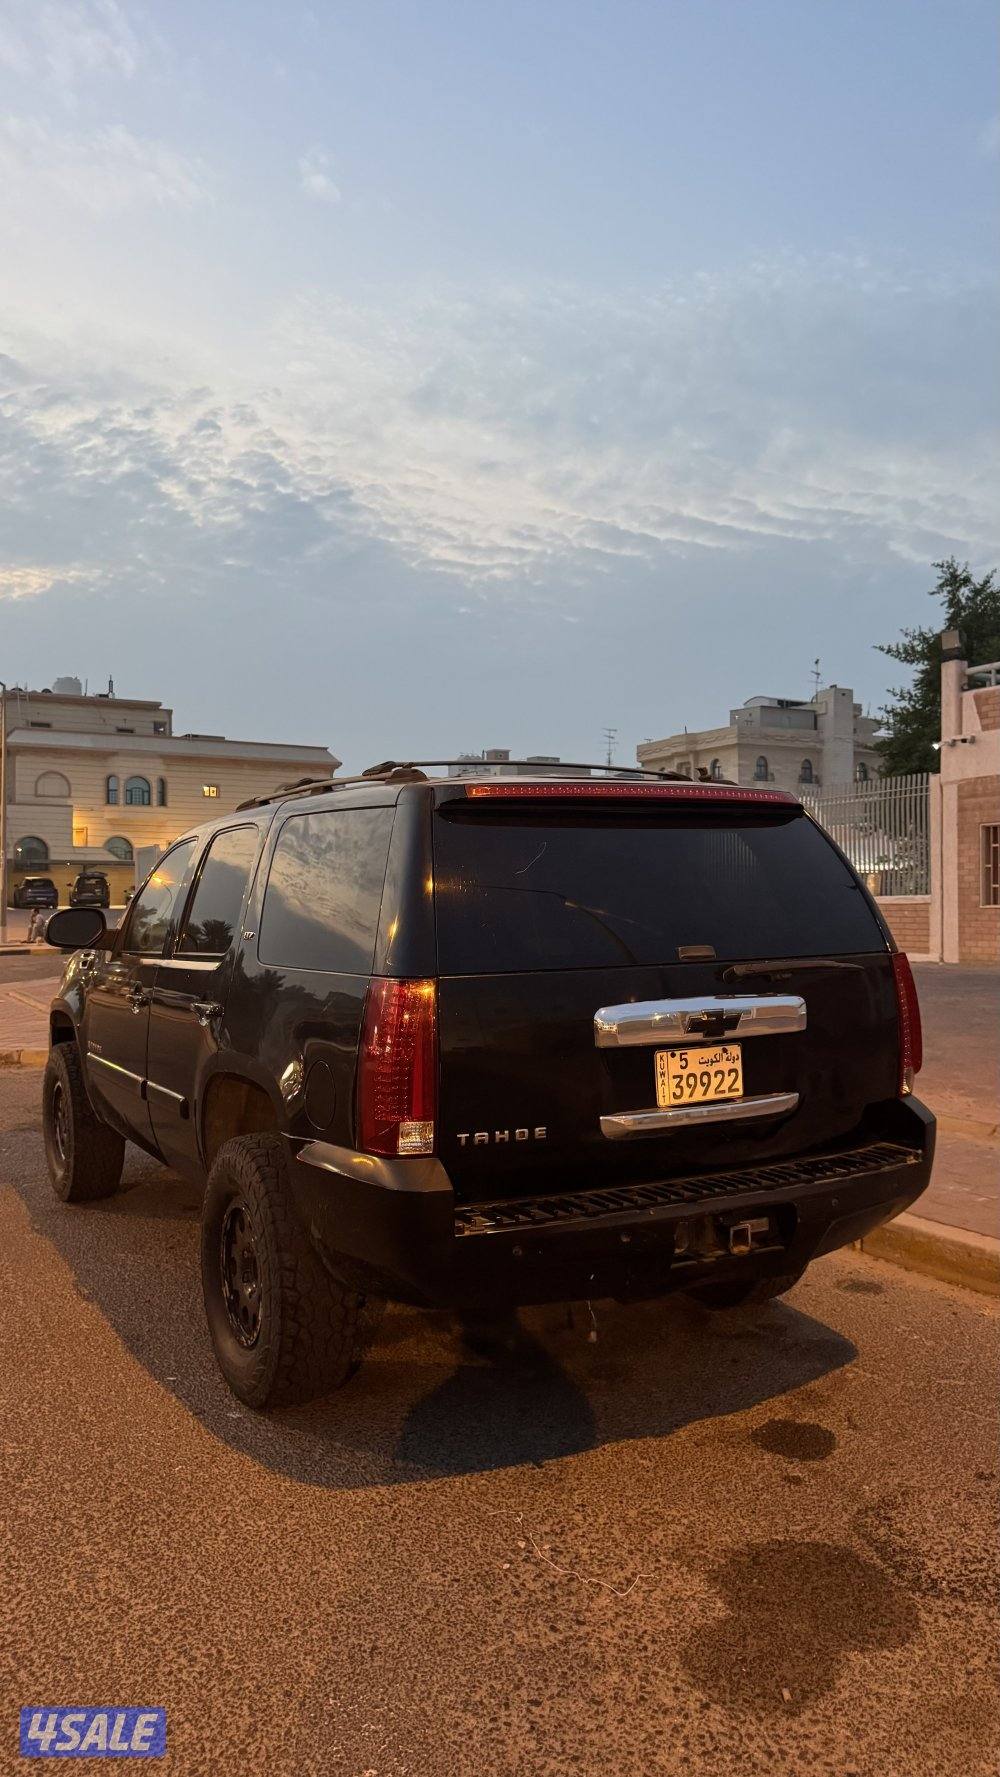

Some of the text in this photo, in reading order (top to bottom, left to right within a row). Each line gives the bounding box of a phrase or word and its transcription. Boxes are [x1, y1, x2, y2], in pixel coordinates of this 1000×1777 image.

[679, 1052, 688, 1070] 5
[698, 1052, 724, 1067] الكويت
[672, 1068, 740, 1100] 39922
[456, 1126, 548, 1147] TAHOE
